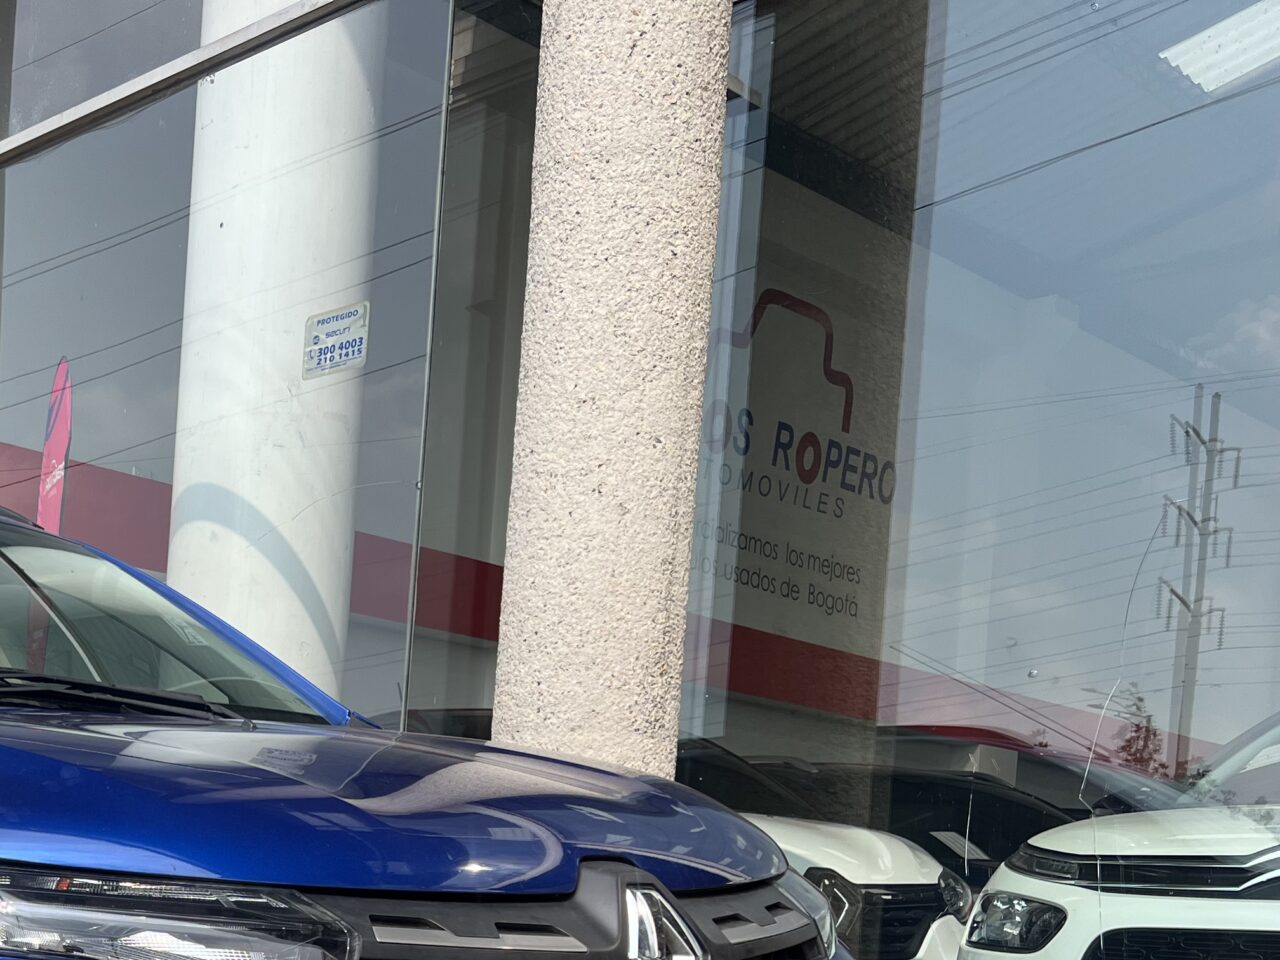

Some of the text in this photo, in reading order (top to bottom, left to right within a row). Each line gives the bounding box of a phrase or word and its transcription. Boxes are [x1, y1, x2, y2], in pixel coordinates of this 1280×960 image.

[316, 309, 359, 327] PROTEGIDO
[316, 336, 364, 358] 300 4003
[316, 355, 335, 366] 210
[338, 347, 363, 360] 1415
[771, 421, 896, 505] ROPERO
[785, 541, 804, 569] los
[807, 551, 862, 585] mejores
[723, 563, 776, 594] usados
[780, 577, 801, 601] de
[808, 583, 859, 617] Bogotá
